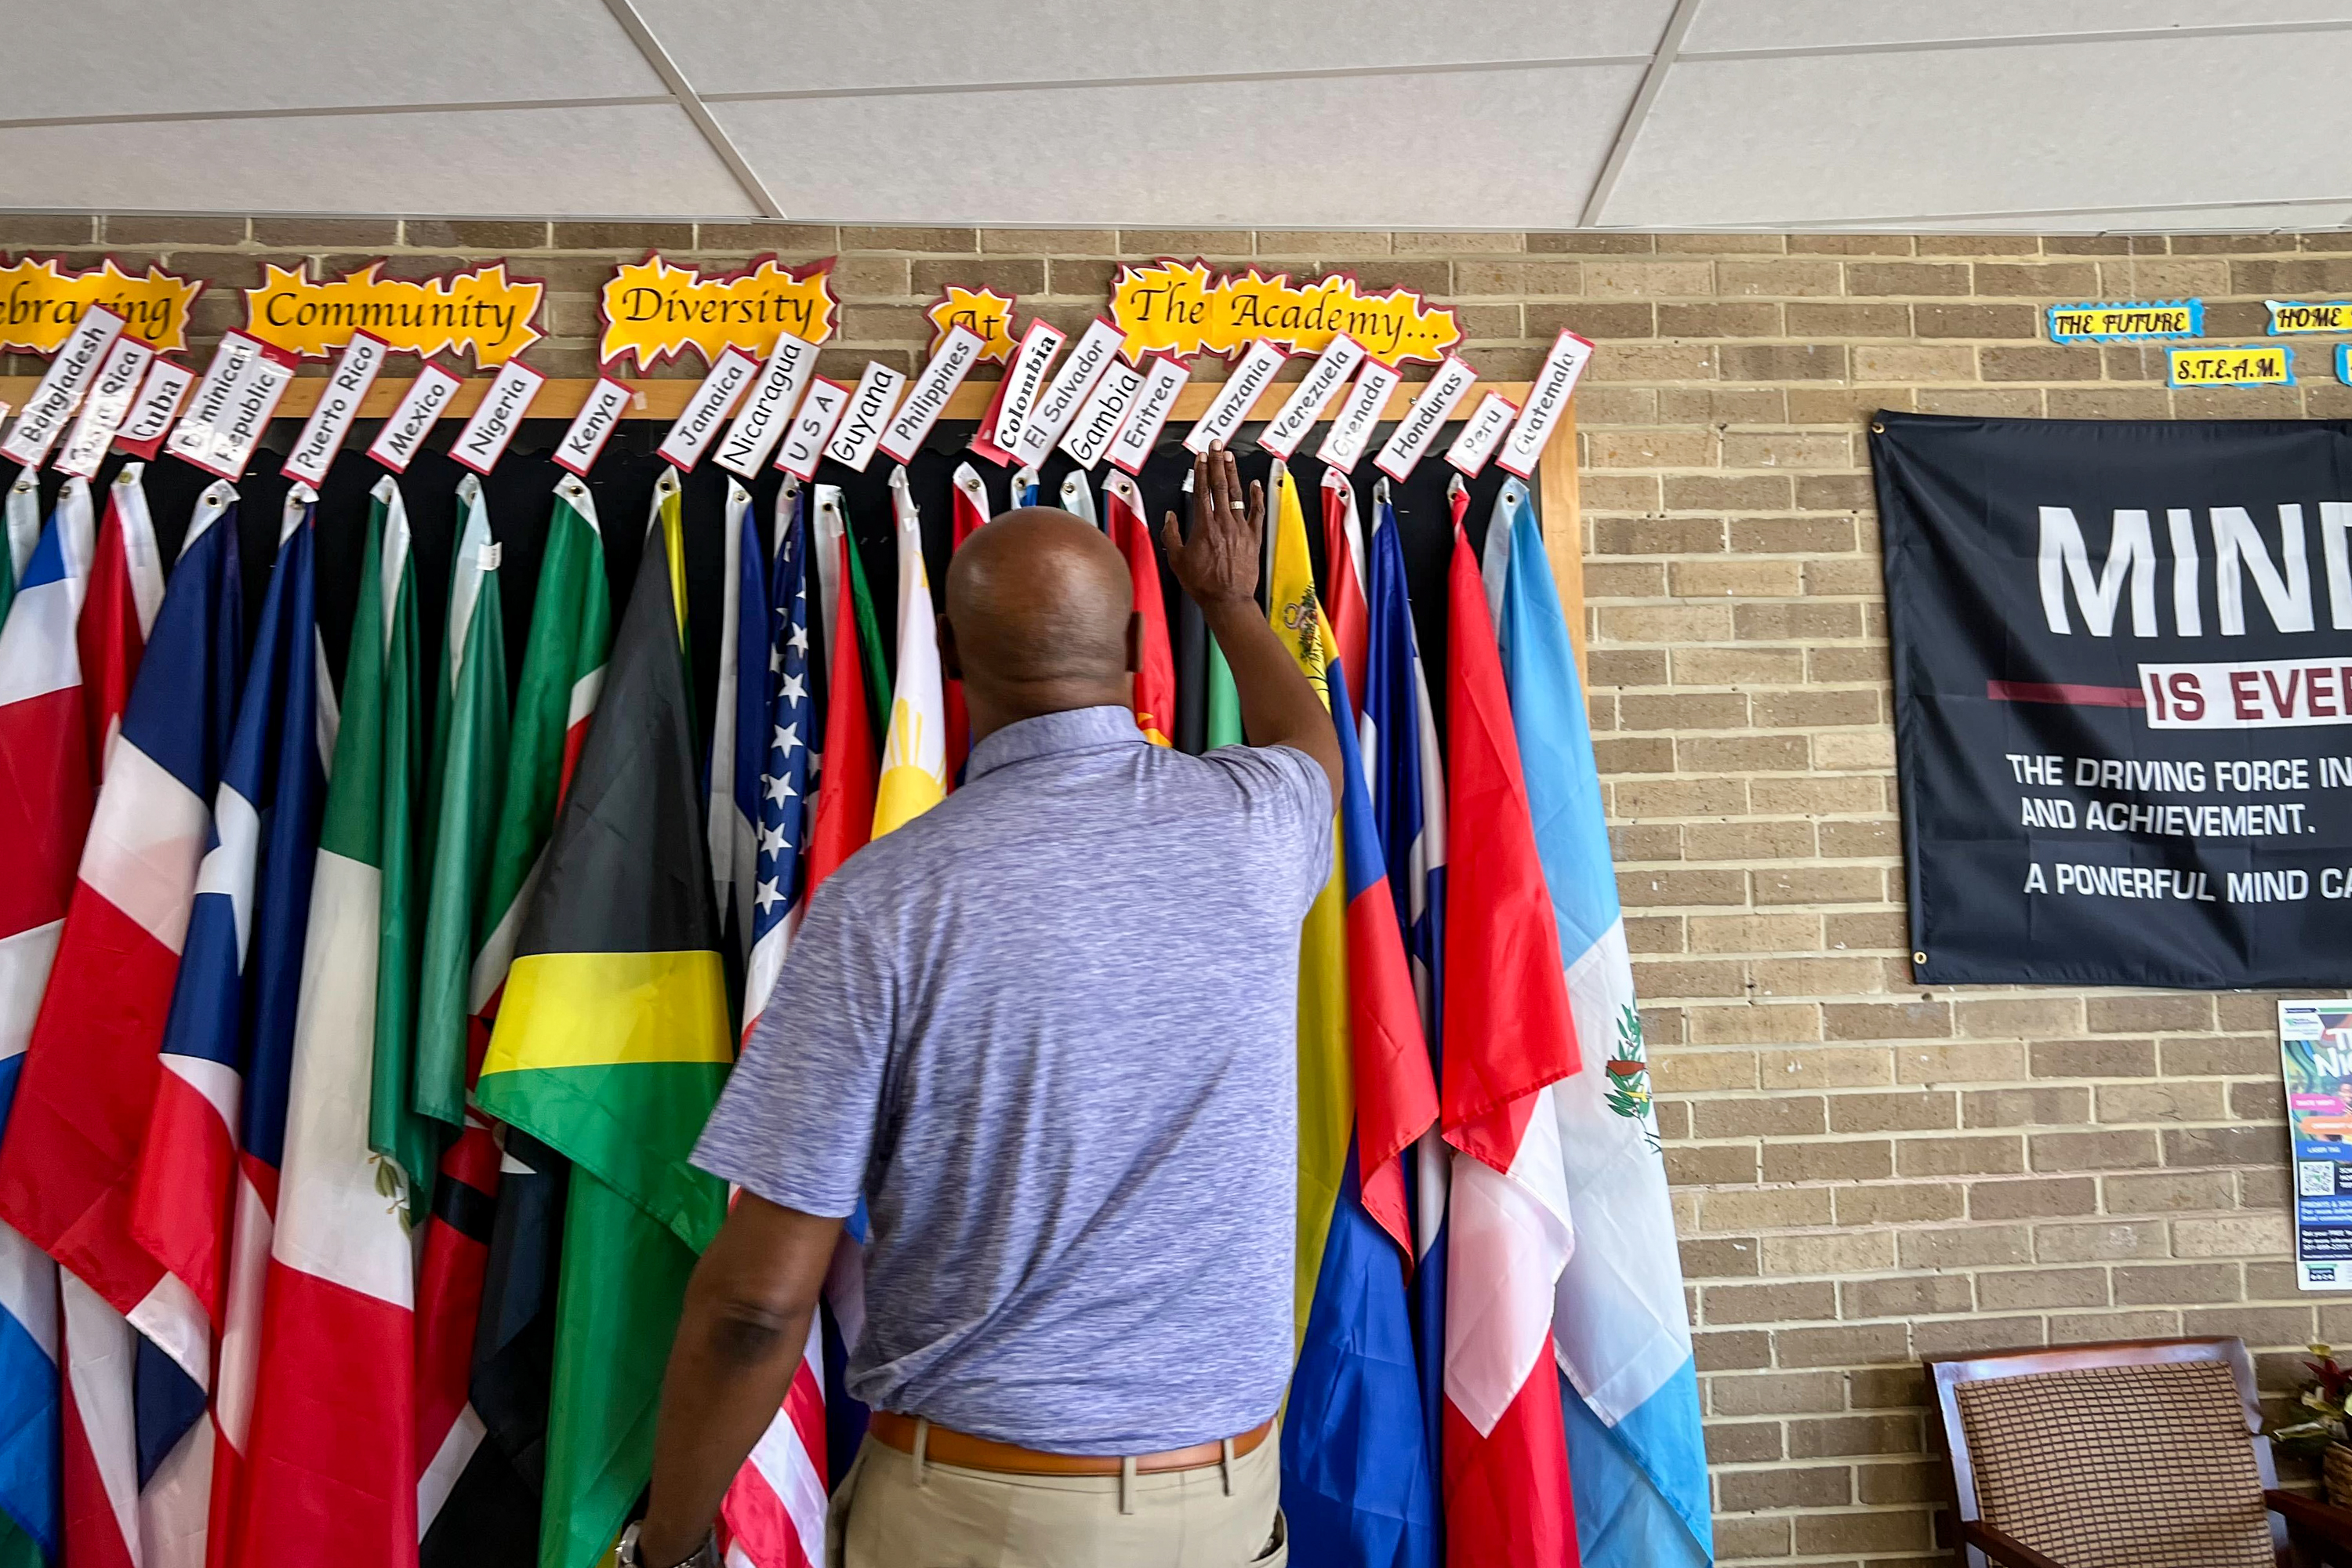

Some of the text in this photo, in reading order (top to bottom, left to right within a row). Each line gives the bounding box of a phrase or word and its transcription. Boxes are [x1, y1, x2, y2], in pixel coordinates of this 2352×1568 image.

[0, 280, 172, 340] braing
[266, 292, 516, 346] Community
[622, 287, 814, 337] Diversity
[1131, 281, 1439, 354] The Academy...
[2054, 311, 2187, 335] THE FUTURE
[2277, 307, 2343, 328] HOME
[20, 326, 107, 443] Bangladesh
[101, 351, 141, 395] Rica
[180, 345, 251, 447] Dminica
[678, 365, 744, 446] Jamaica
[723, 343, 803, 466] Nicaragua
[895, 341, 971, 441] Philippines
[1000, 336, 1057, 448] Colombia
[1023, 339, 1104, 449] El Salvador
[1202, 358, 1272, 437] Tanzania
[1514, 353, 1575, 455] Guatemala
[2177, 357, 2281, 380] S.T.E.A.M.
[132, 379, 183, 437] Cuba
[296, 346, 372, 469] Puerto Rico
[388, 383, 446, 456] Mexico
[470, 379, 527, 456] Nigeria
[568, 392, 618, 456] Kenya
[831, 369, 894, 464] Guyana
[1071, 375, 1140, 460] Gambia
[1123, 375, 1175, 450] Eritrea
[1333, 376, 1386, 457] Grenada
[1392, 372, 1461, 459] Honduras
[1464, 409, 1502, 455] Peru
[2148, 673, 2205, 720] IS
[2006, 754, 2063, 786] THE
[2074, 757, 2206, 792] DRIVING
[2214, 758, 2310, 792] FORCE
[2021, 797, 2316, 837] AND ACHIEVEMENT.
[2024, 862, 2049, 895] A
[2055, 863, 2216, 902] POWERFUL
[2227, 869, 2308, 902] MIND
